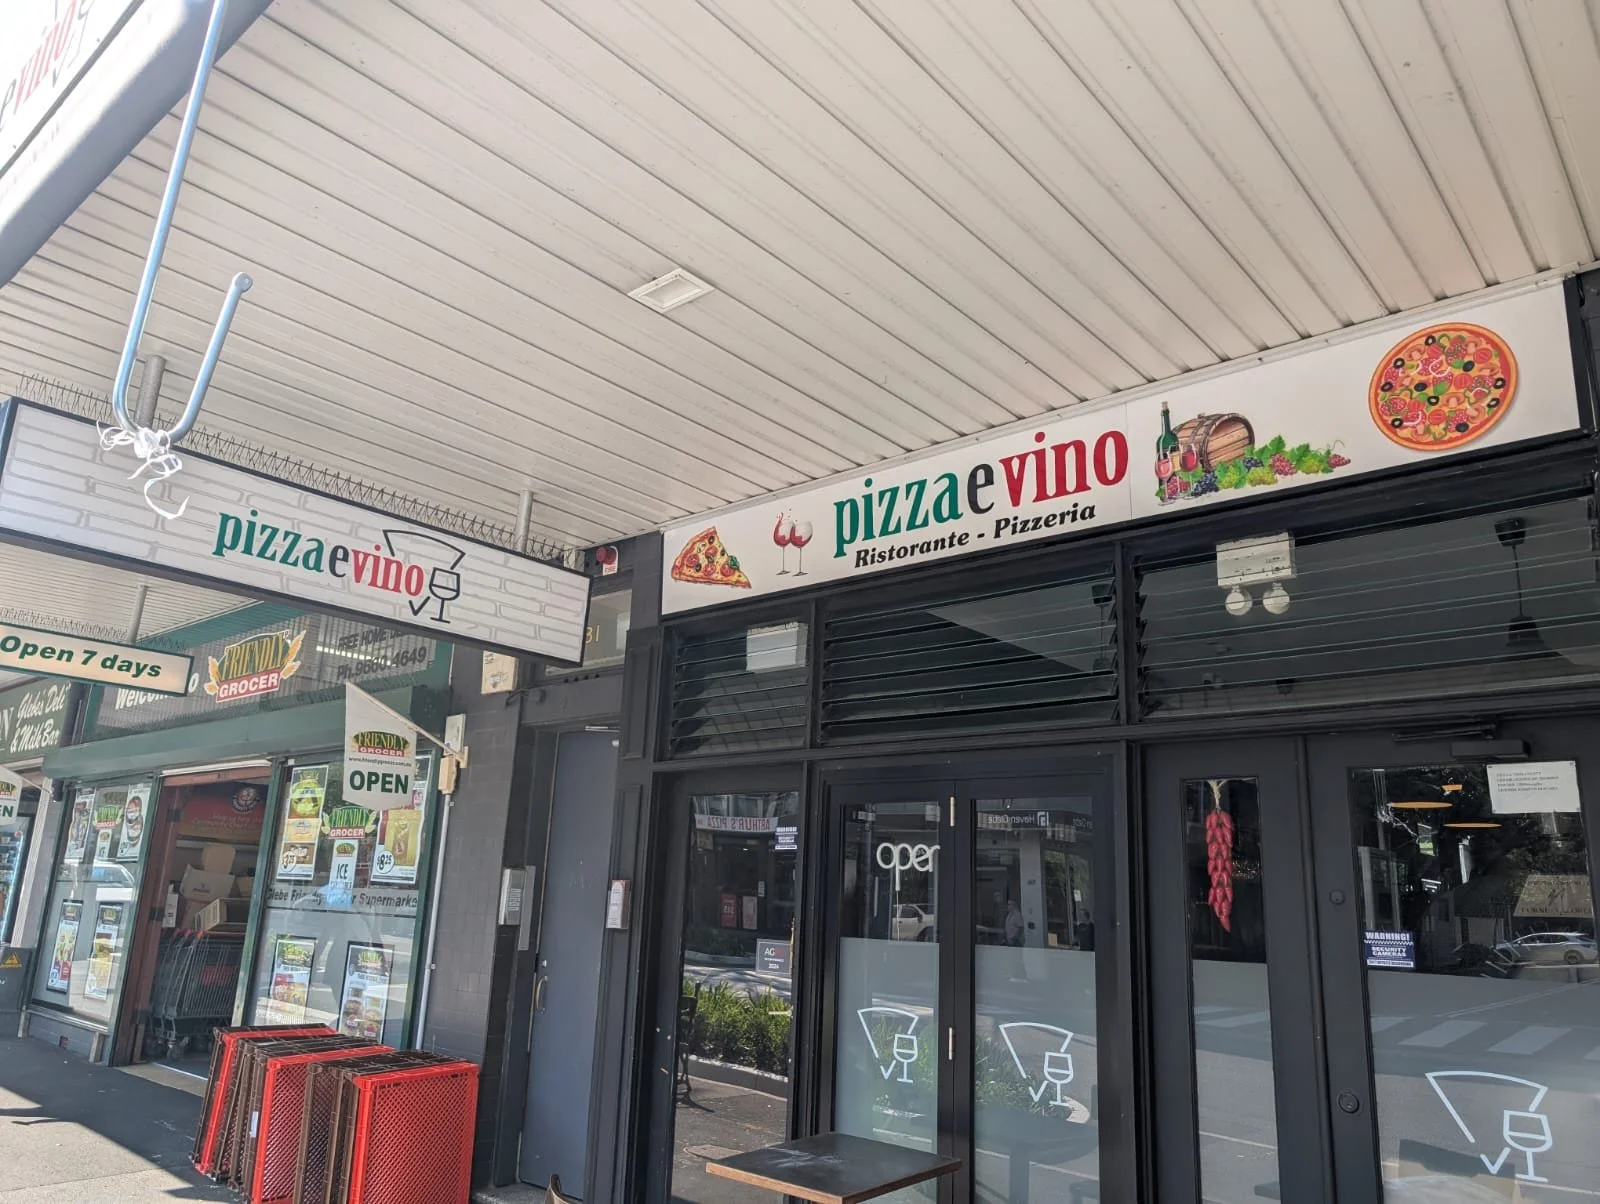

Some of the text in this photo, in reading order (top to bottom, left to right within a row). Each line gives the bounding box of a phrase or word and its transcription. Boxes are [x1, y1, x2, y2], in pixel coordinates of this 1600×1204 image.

[854, 530, 970, 568] Ristorante
[993, 502, 1096, 539] Pizzeria
[338, 632, 359, 650] FREE
[361, 629, 389, 646] HOME
[0, 635, 162, 678] Open 7 days
[222, 632, 285, 680] FRIENDLY
[219, 673, 279, 698] GROCER
[18, 722, 44, 752] Milk
[41, 718, 61, 748] Bar
[358, 732, 405, 750] FRIENDLY
[360, 747, 403, 756] GROCER
[349, 770, 409, 795] OPEN
[330, 828, 364, 837] GROCER
[336, 864, 348, 880] ICE
[1365, 932, 1410, 941] WARNING!
